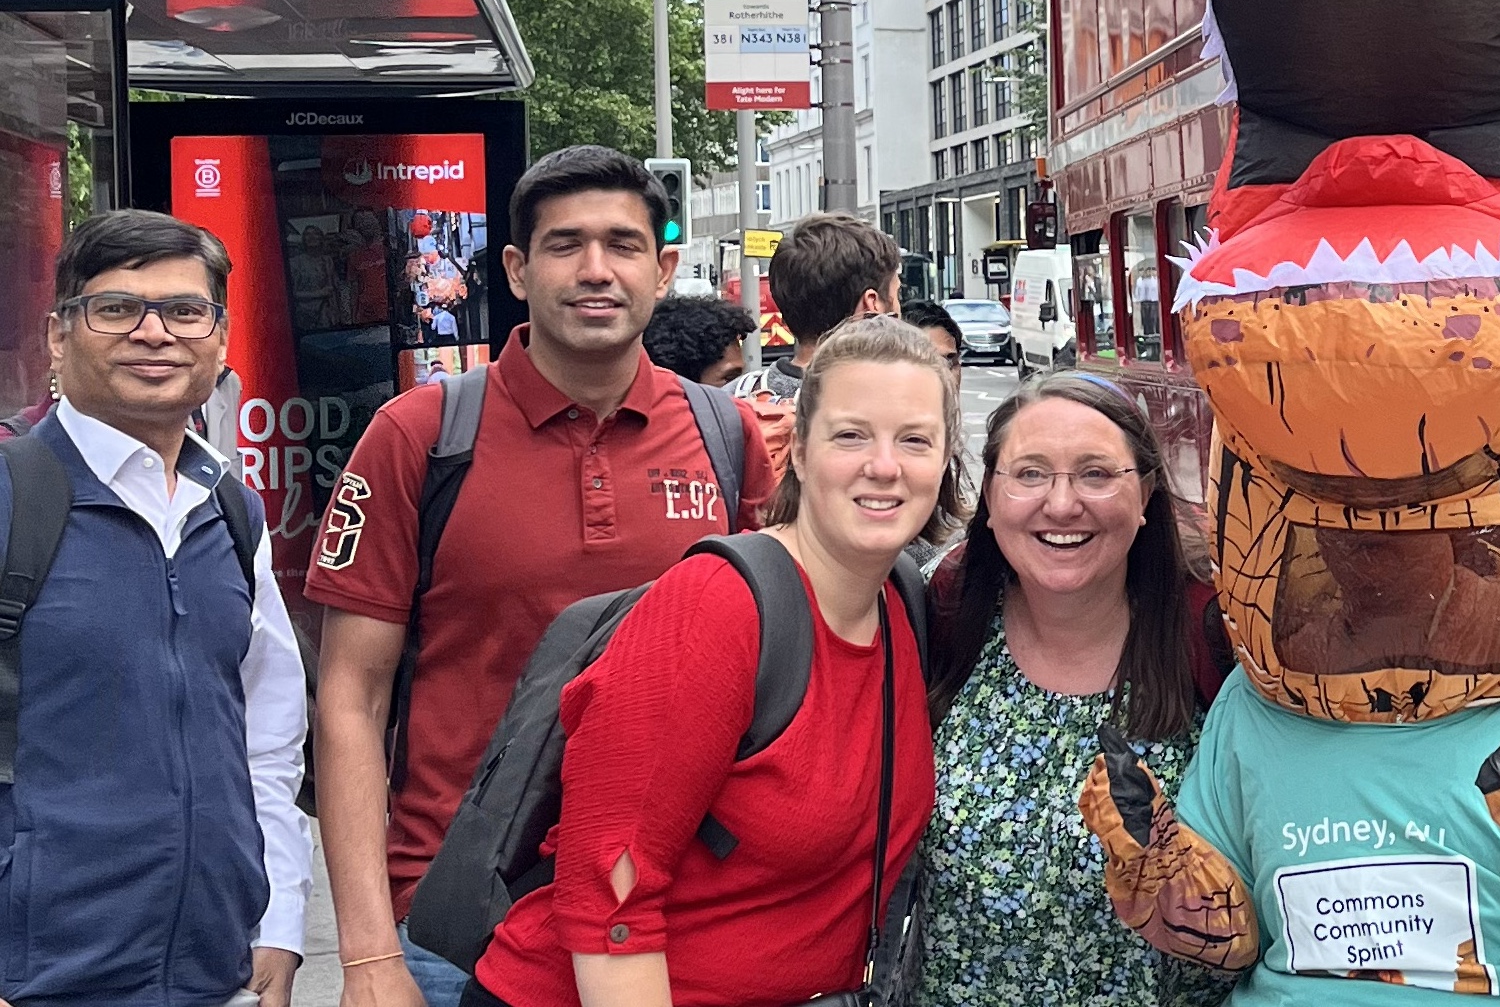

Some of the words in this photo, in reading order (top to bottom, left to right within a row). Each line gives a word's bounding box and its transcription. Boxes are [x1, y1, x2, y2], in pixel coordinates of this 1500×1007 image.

[729, 11, 784, 20] Rotherhithe
[713, 34, 733, 44] 381
[741, 33, 773, 43] N343
[776, 33, 807, 43] N381
[732, 86, 754, 95] Alight
[755, 86, 773, 94] here
[285, 112, 364, 125] JCDecaux
[377, 159, 465, 184] Intrepid
[663, 479, 718, 521] E.92
[1282, 817, 1396, 856] Sydney,
[1316, 893, 1425, 916] Commons
[1313, 914, 1434, 942] Community
[1347, 940, 1404, 967] Sprint
